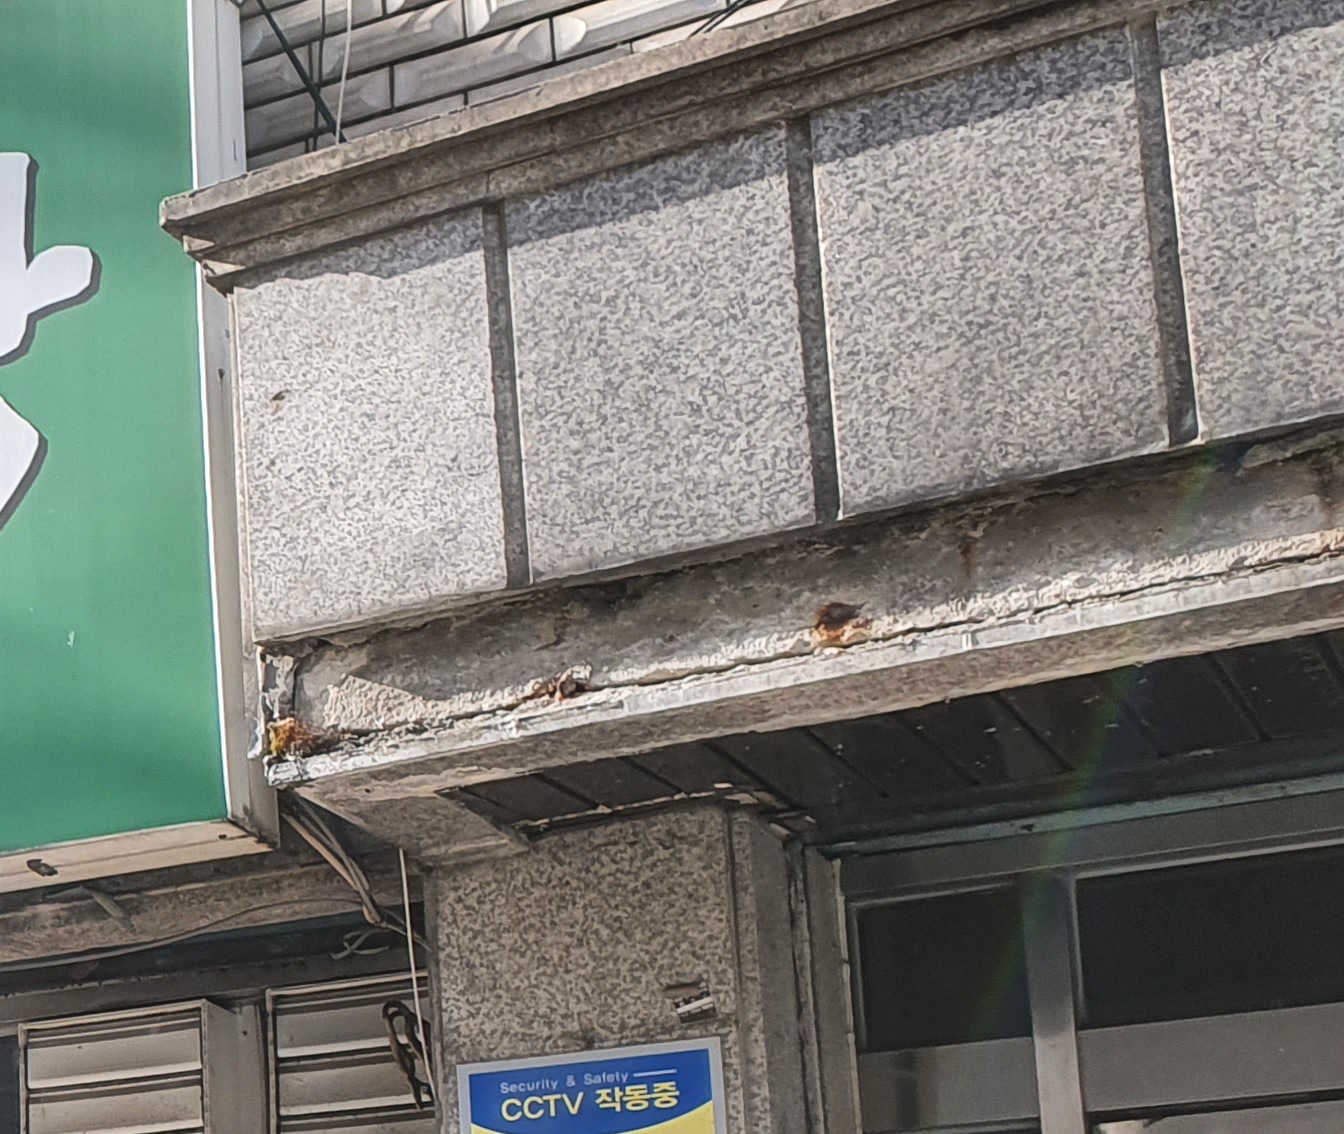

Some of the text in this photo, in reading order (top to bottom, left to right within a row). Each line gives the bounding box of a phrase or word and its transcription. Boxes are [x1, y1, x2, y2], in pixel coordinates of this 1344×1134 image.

[500, 1070, 629, 1096] Security & Safety
[500, 1080, 680, 1123] CCTV 작동중
